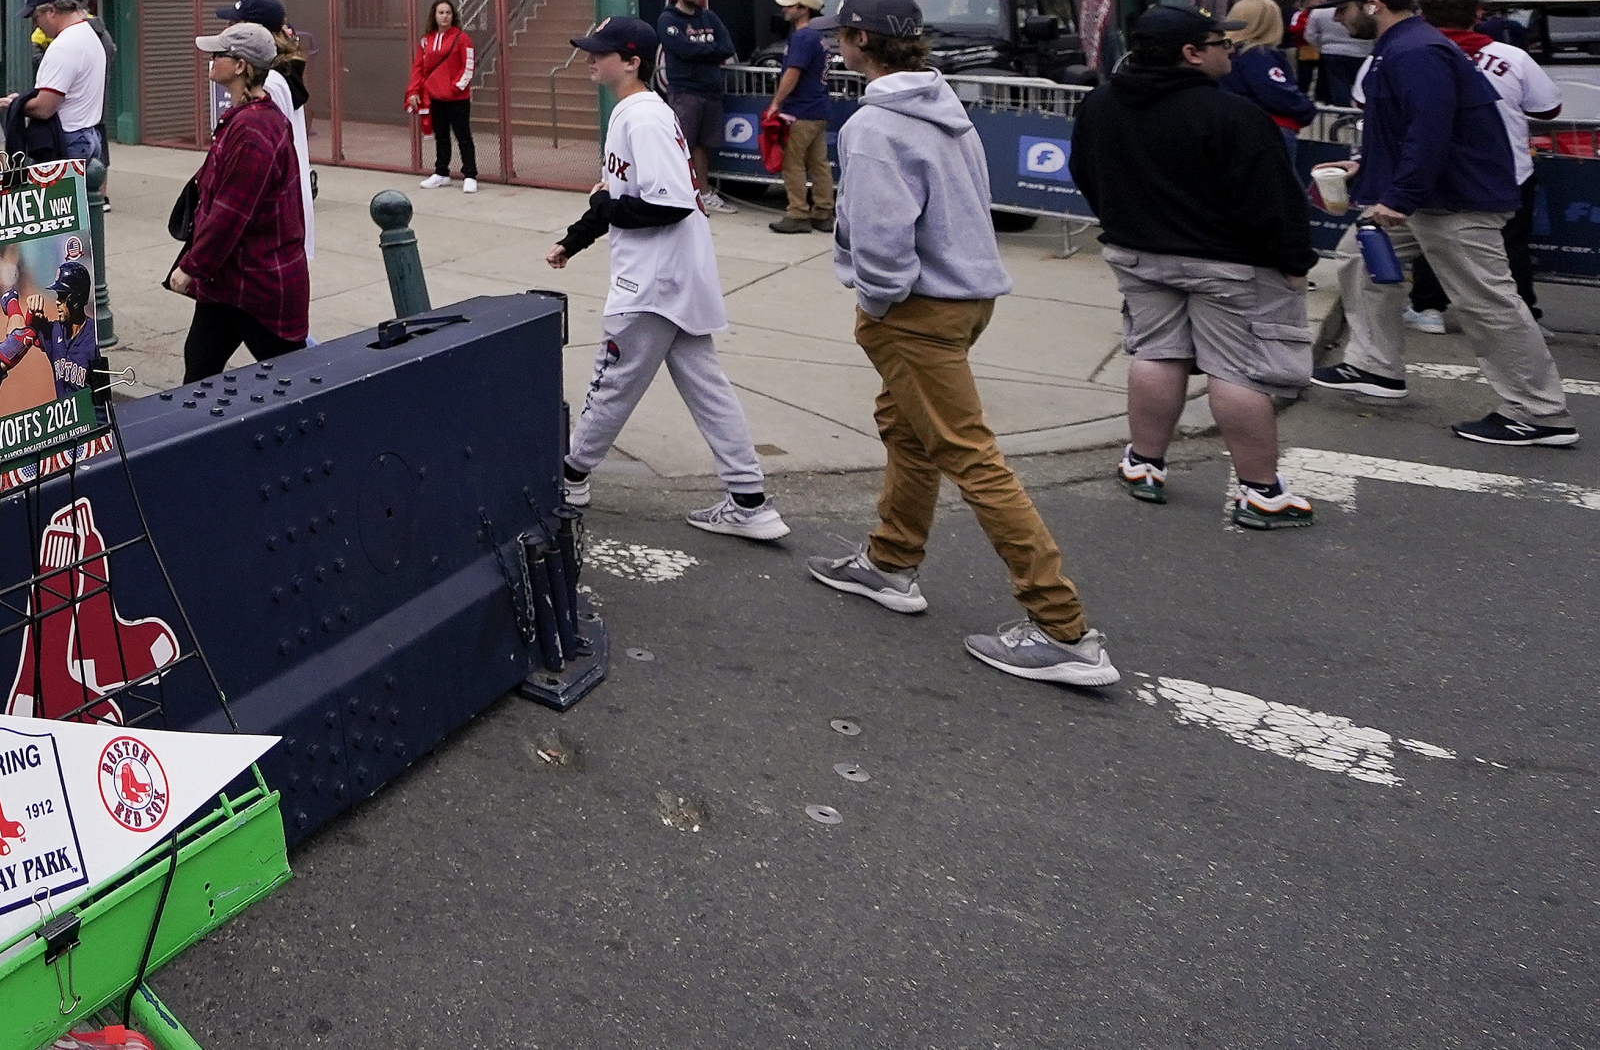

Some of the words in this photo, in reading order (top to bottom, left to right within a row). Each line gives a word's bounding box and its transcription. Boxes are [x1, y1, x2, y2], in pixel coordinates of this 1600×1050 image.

[602, 152, 631, 182] OX
[49, 196, 73, 217] WAY
[46, 397, 79, 434] 2021
[102, 740, 151, 776] BOSTON
[25, 799, 54, 820] 1912
[114, 801, 142, 827] RED
[148, 788, 166, 824] SOX
[22, 846, 73, 883] PARK
